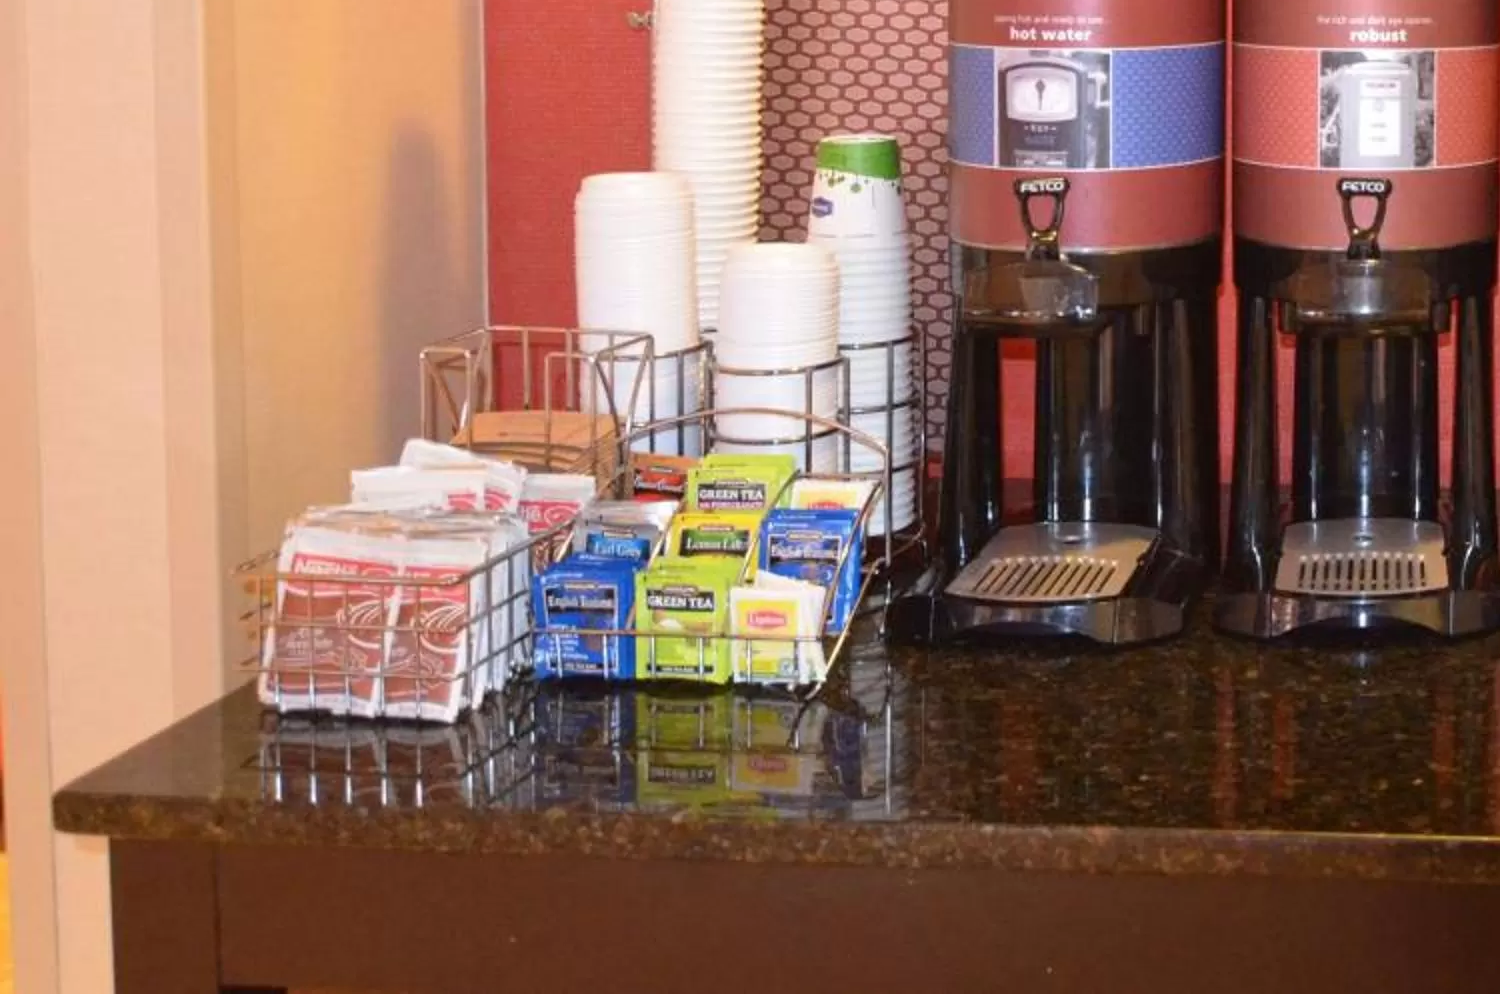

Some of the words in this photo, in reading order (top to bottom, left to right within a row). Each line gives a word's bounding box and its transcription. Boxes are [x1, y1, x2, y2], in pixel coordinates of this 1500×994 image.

[1009, 26, 1037, 41] hot
[1041, 27, 1092, 42] water
[1349, 27, 1408, 43] robust
[1021, 180, 1065, 193] FETCO
[1341, 181, 1385, 193] FETCO
[699, 489, 738, 501] GREEN
[740, 489, 763, 501] TEA
[648, 594, 687, 608] GREEN
[688, 596, 714, 609] TEA
